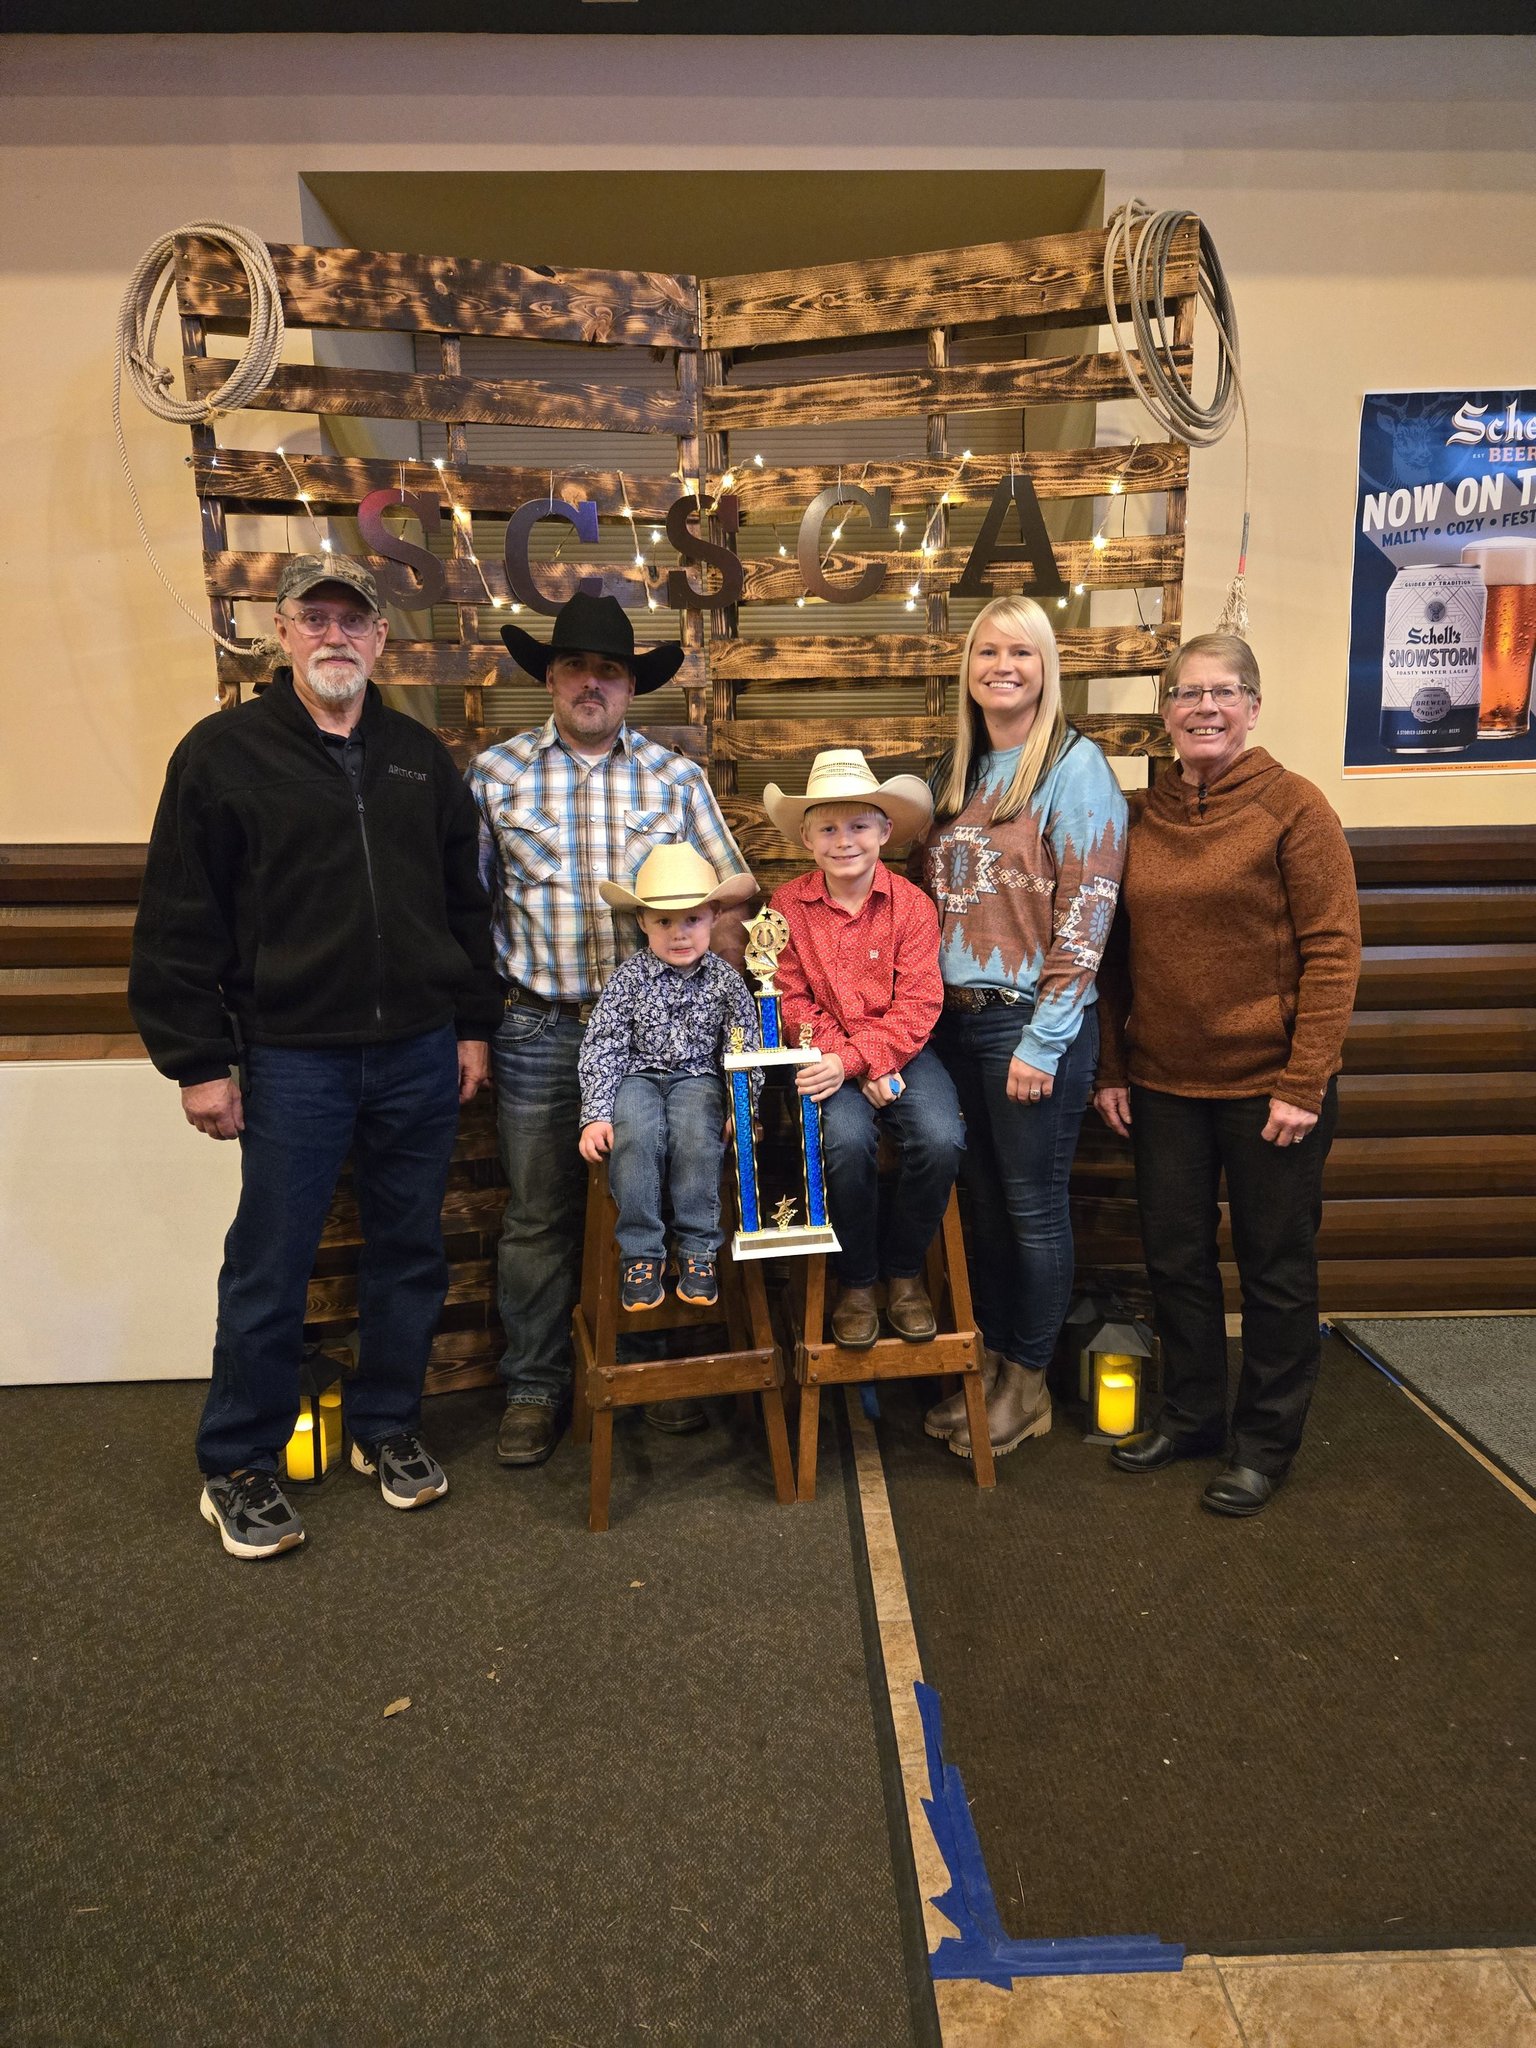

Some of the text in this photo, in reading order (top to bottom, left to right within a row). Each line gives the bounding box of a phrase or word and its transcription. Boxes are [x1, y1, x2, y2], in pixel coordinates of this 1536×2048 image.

[1362, 467, 1536, 533] NOW ON T
[1382, 527, 1429, 547] MALTY
[1446, 517, 1485, 536] COZY
[1405, 625, 1461, 645] Schell's
[1389, 647, 1477, 667] SNOWSTORM
[731, 1026, 744, 1040] 20
